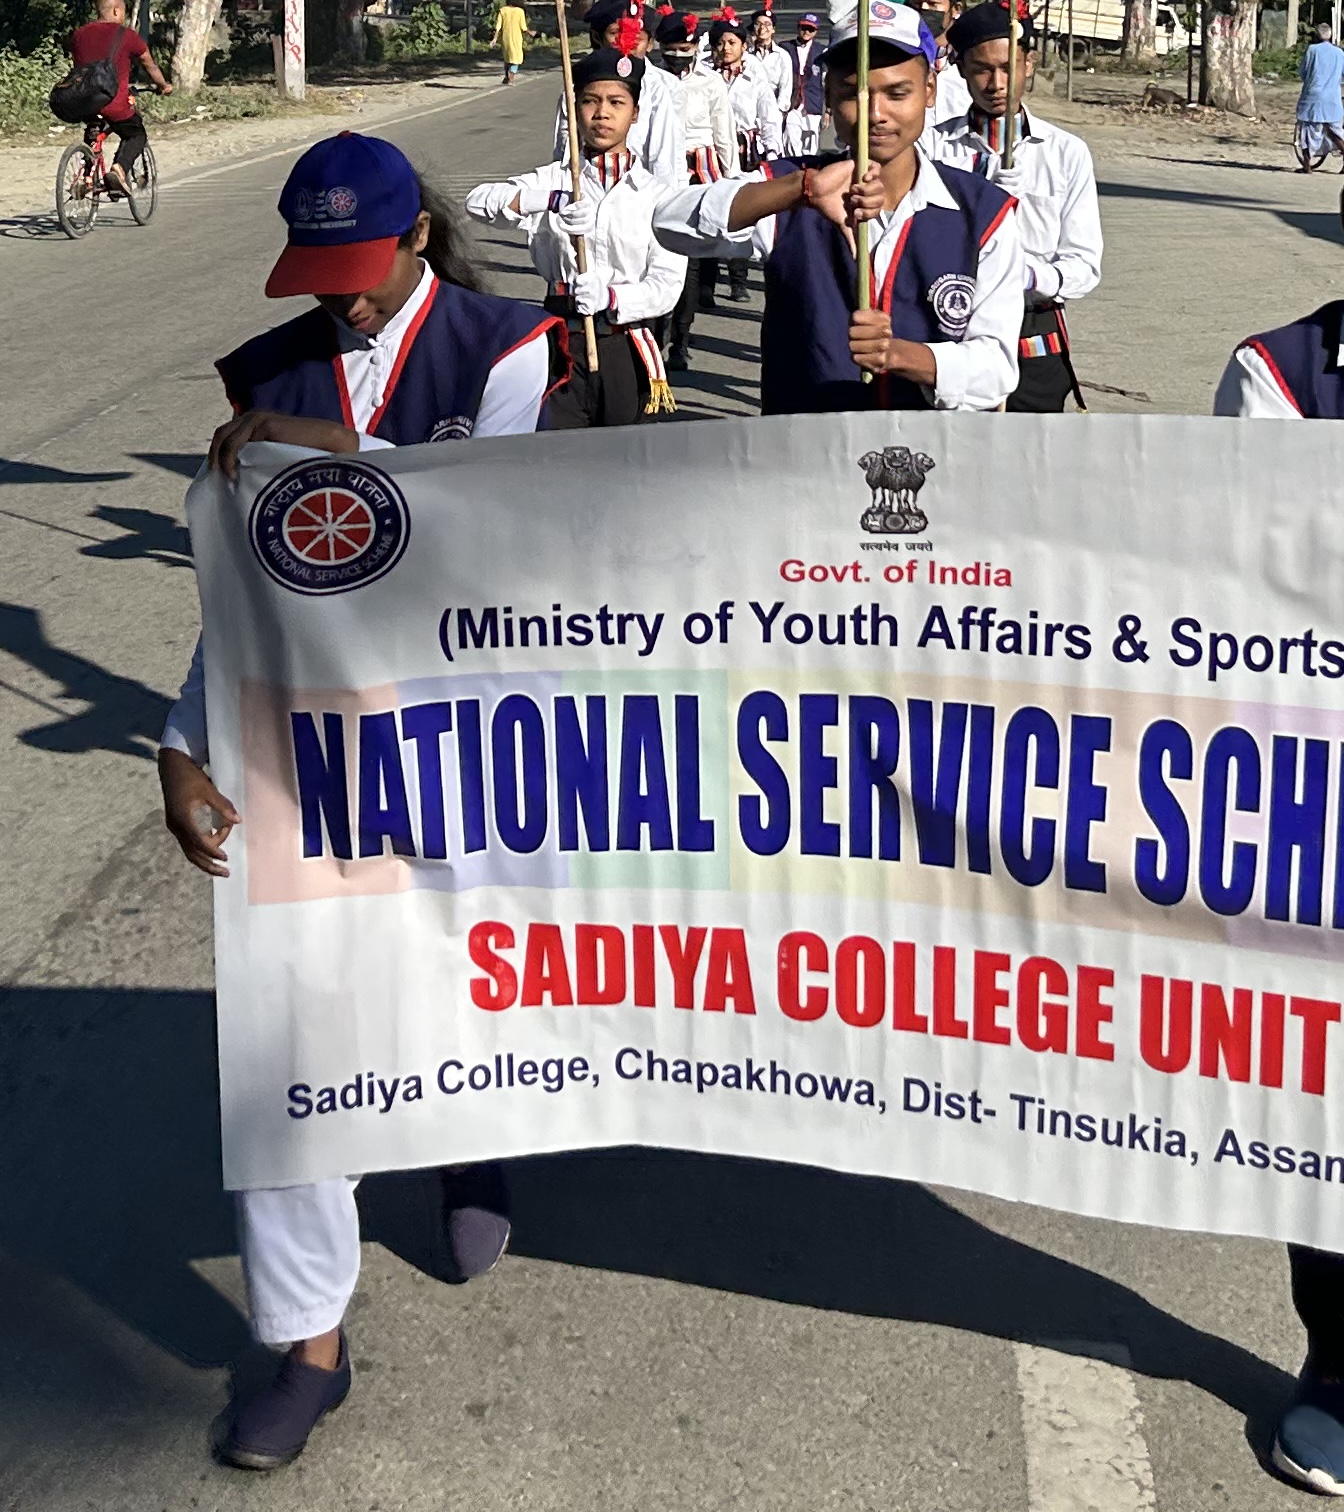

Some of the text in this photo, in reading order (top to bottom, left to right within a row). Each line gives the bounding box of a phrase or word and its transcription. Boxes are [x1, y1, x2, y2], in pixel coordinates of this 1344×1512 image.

[267, 533, 394, 582] NATIONAL SERVICE SCHEME
[779, 559, 1013, 587] Govt. of India
[904, 539, 934, 552] जयते
[438, 603, 665, 662] (Ministry
[683, 600, 735, 646] of
[748, 601, 899, 648] Youth
[917, 605, 1093, 662] Affairs
[1112, 614, 1150, 665] &
[290, 693, 716, 860] NATIONAL
[736, 690, 1113, 892] SERVICE
[467, 920, 1343, 1097] SADIYA COLLEGE UNIT
[286, 1070, 424, 1121] Sadiya
[436, 1052, 601, 1096] College,
[614, 1046, 888, 1116] Chapakhowa,
[903, 1076, 998, 1125] Dist-
[1008, 1092, 1201, 1168] Tinsukia,
